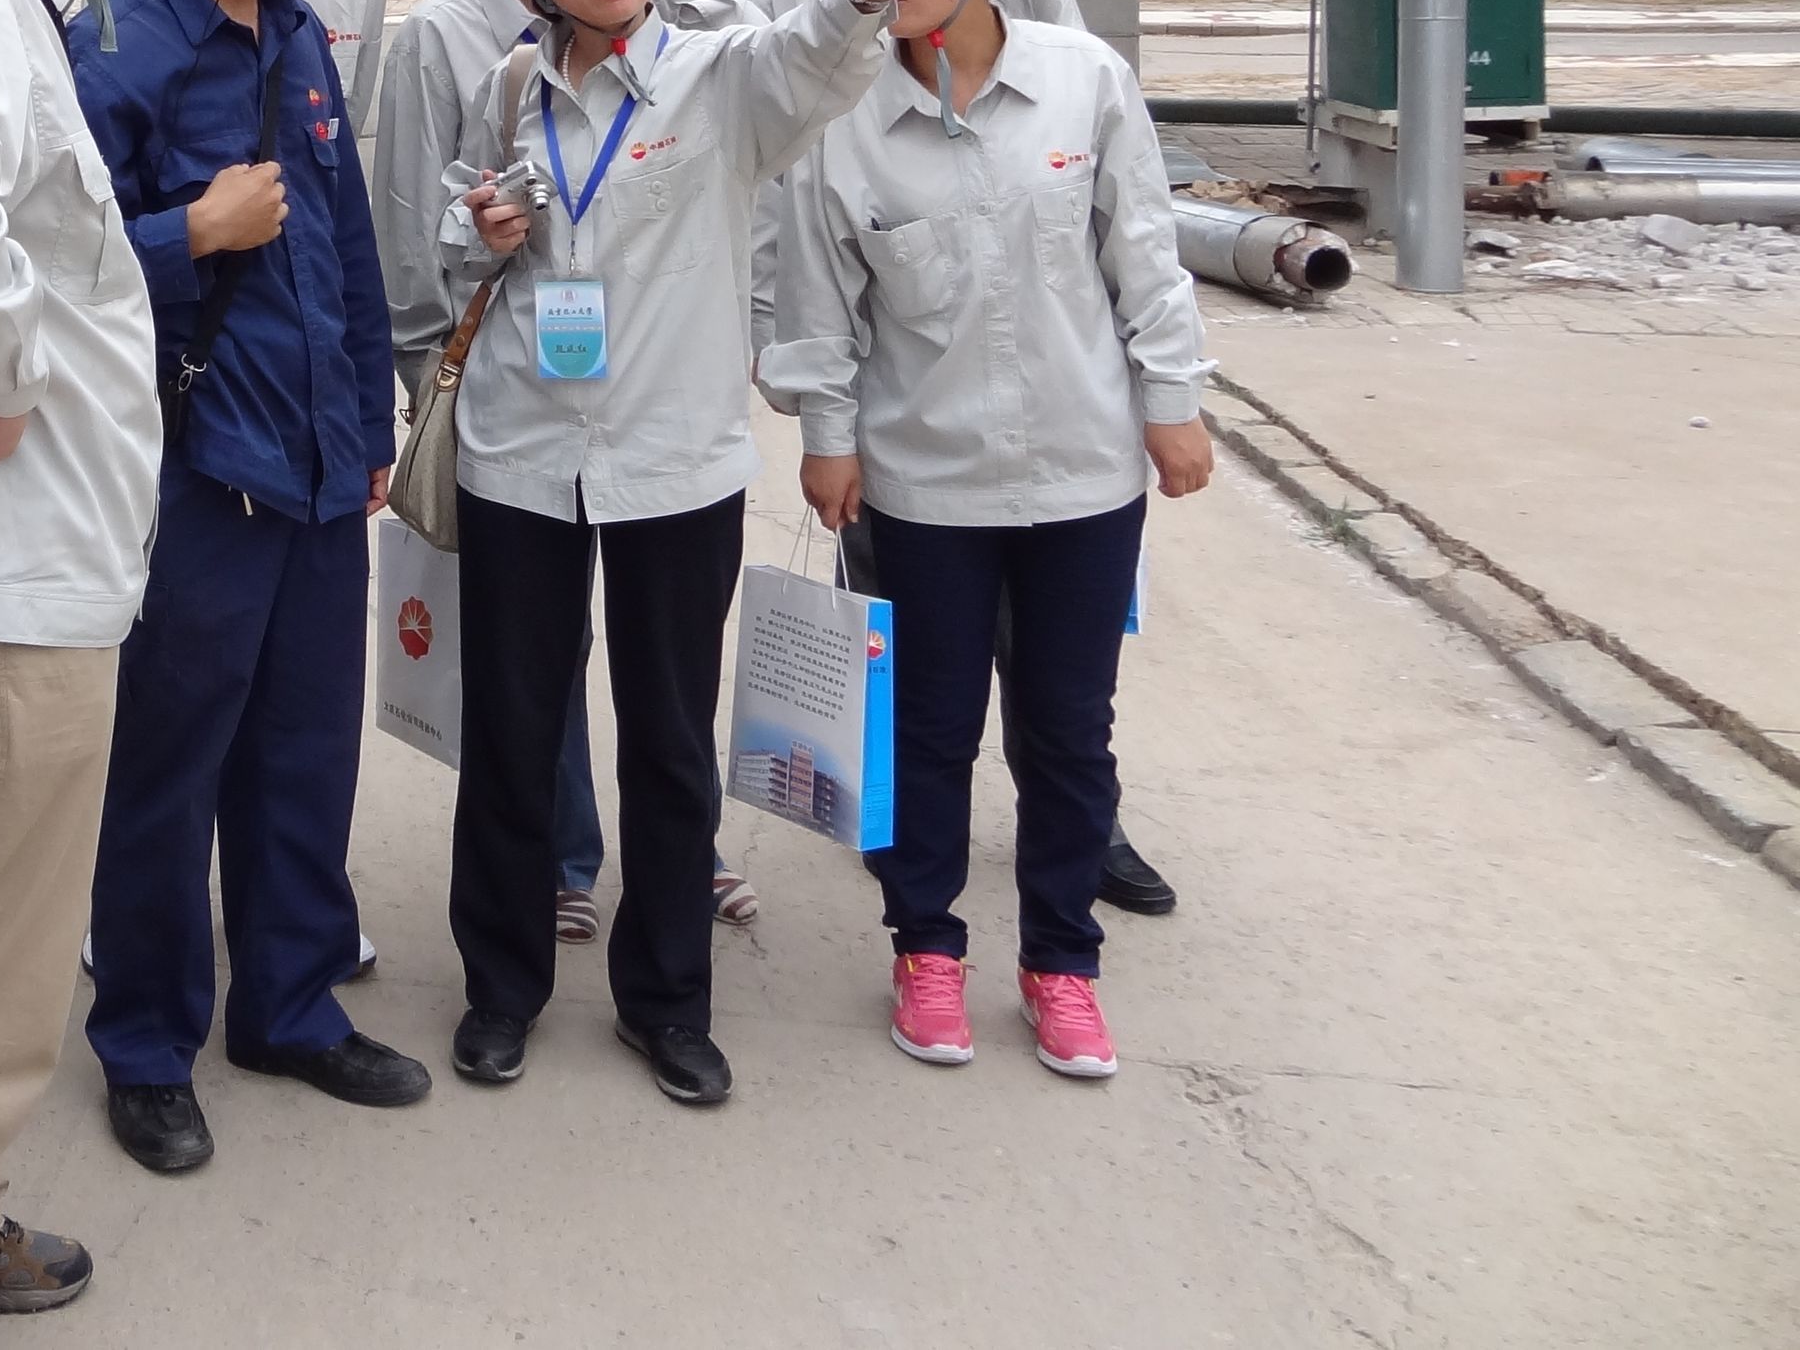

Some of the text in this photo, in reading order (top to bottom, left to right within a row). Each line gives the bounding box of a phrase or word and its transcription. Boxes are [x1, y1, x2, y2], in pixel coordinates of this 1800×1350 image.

[1469, 50, 1492, 66] 44
[649, 136, 677, 151] 中国石油
